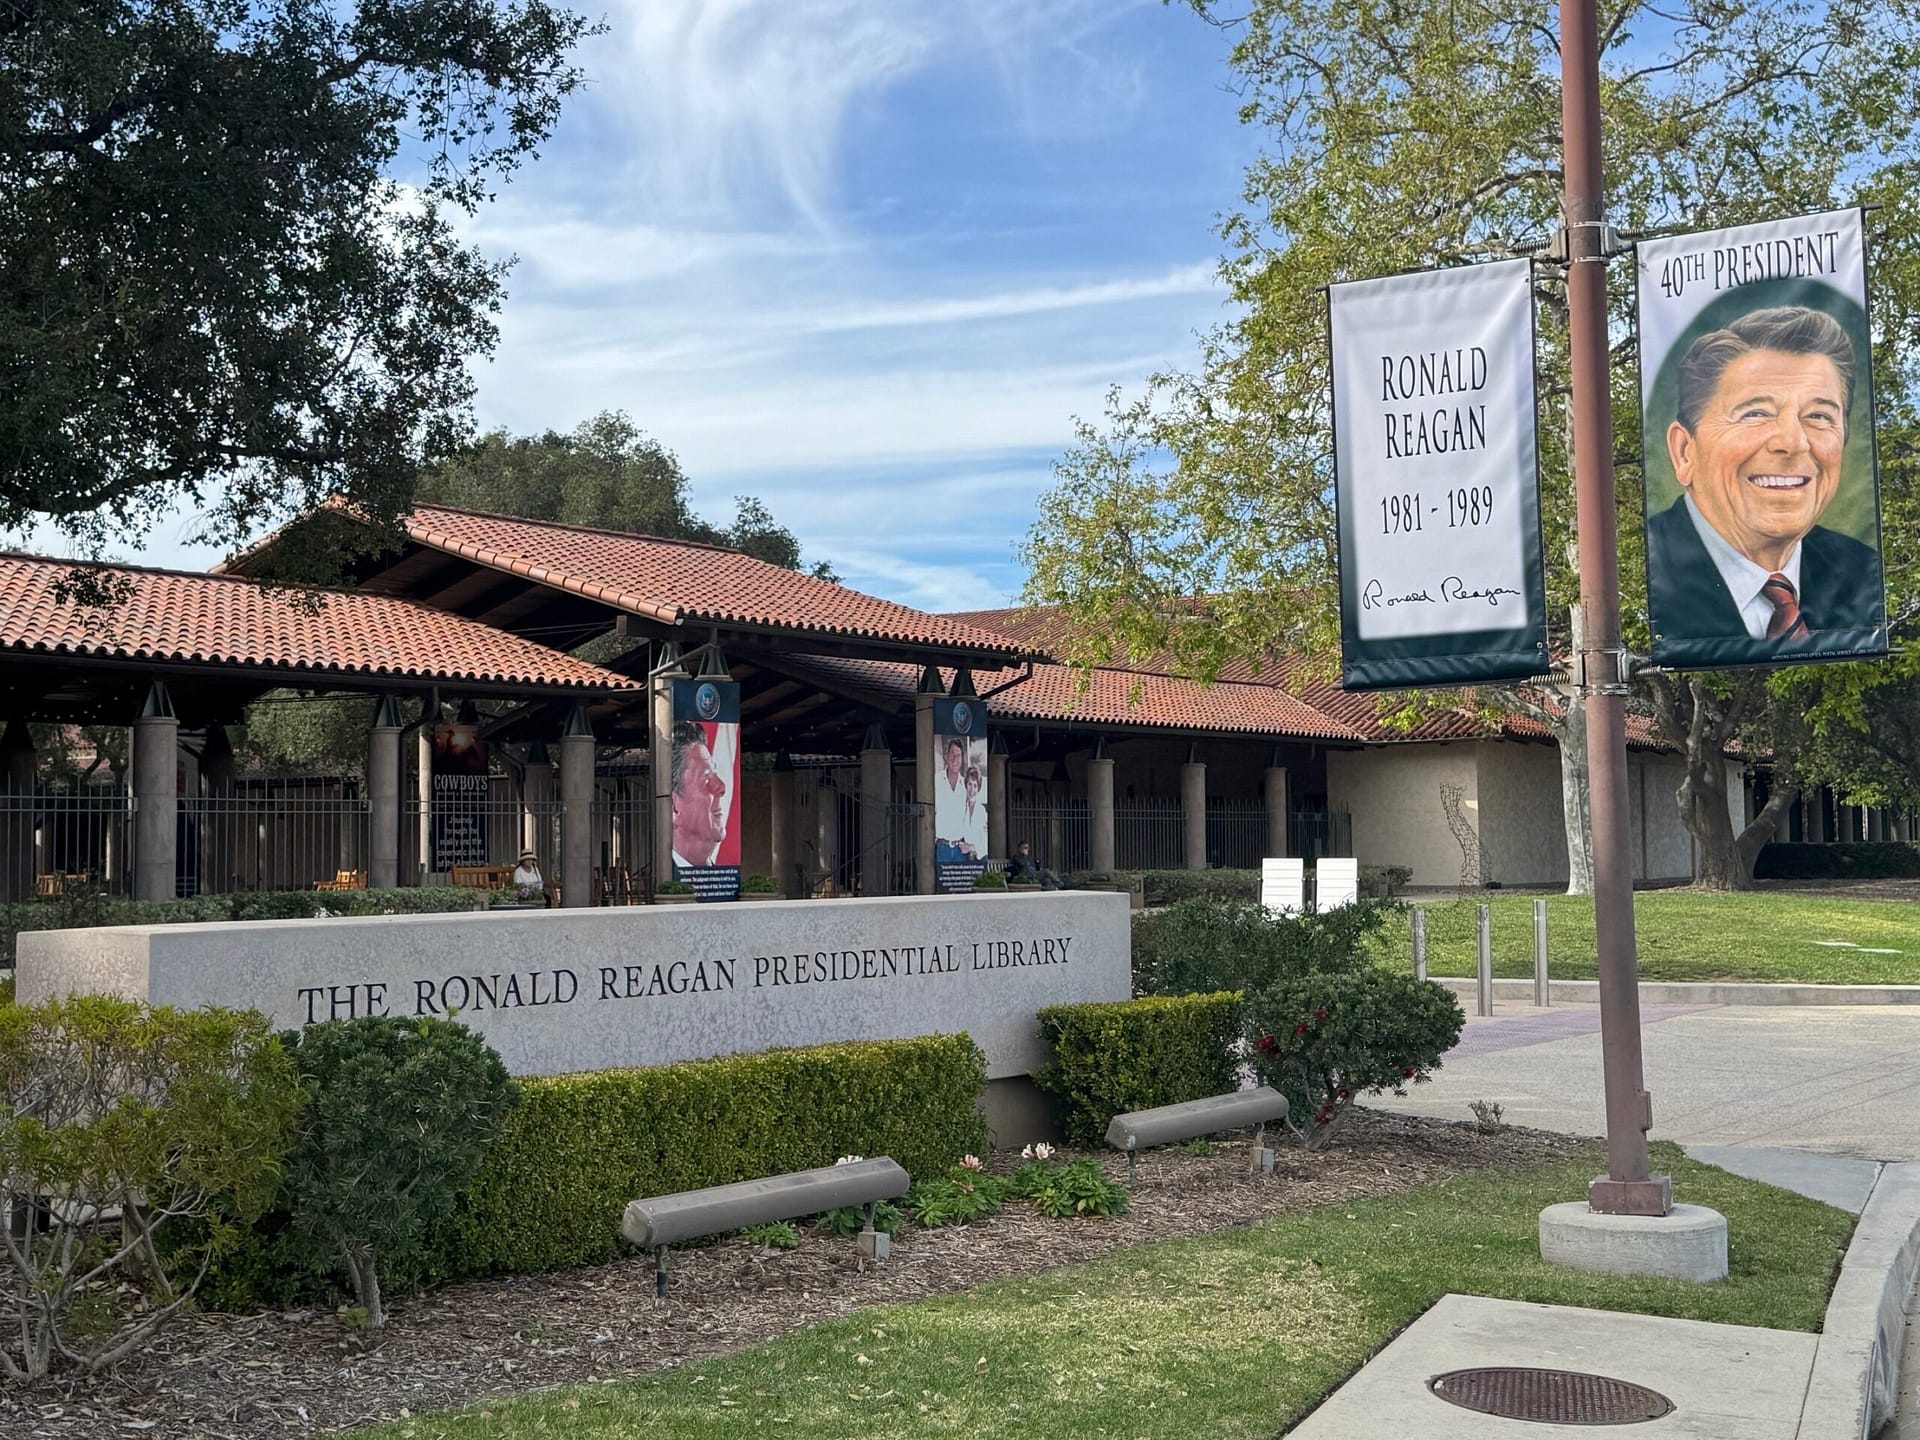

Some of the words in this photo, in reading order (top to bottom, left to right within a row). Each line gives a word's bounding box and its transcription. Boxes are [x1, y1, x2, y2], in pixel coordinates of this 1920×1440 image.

[1660, 253, 1706, 298] 40TH
[1713, 231, 1839, 290] PRESIDENT
[1381, 347, 1488, 402] RONALD
[1384, 405, 1487, 459] REAGAN
[1381, 492, 1423, 534] 1981
[1447, 485, 1494, 528] 1989
[1362, 579, 1436, 610] Ronald
[1441, 576, 1521, 606] Reagan
[434, 774, 488, 791] COWBOYS
[296, 982, 391, 1026] THE
[413, 969, 579, 1016] RONALD
[598, 958, 737, 1001] REAGAN
[752, 944, 961, 988] PRESIDENTIAL
[971, 937, 1073, 971] LIBRARY
